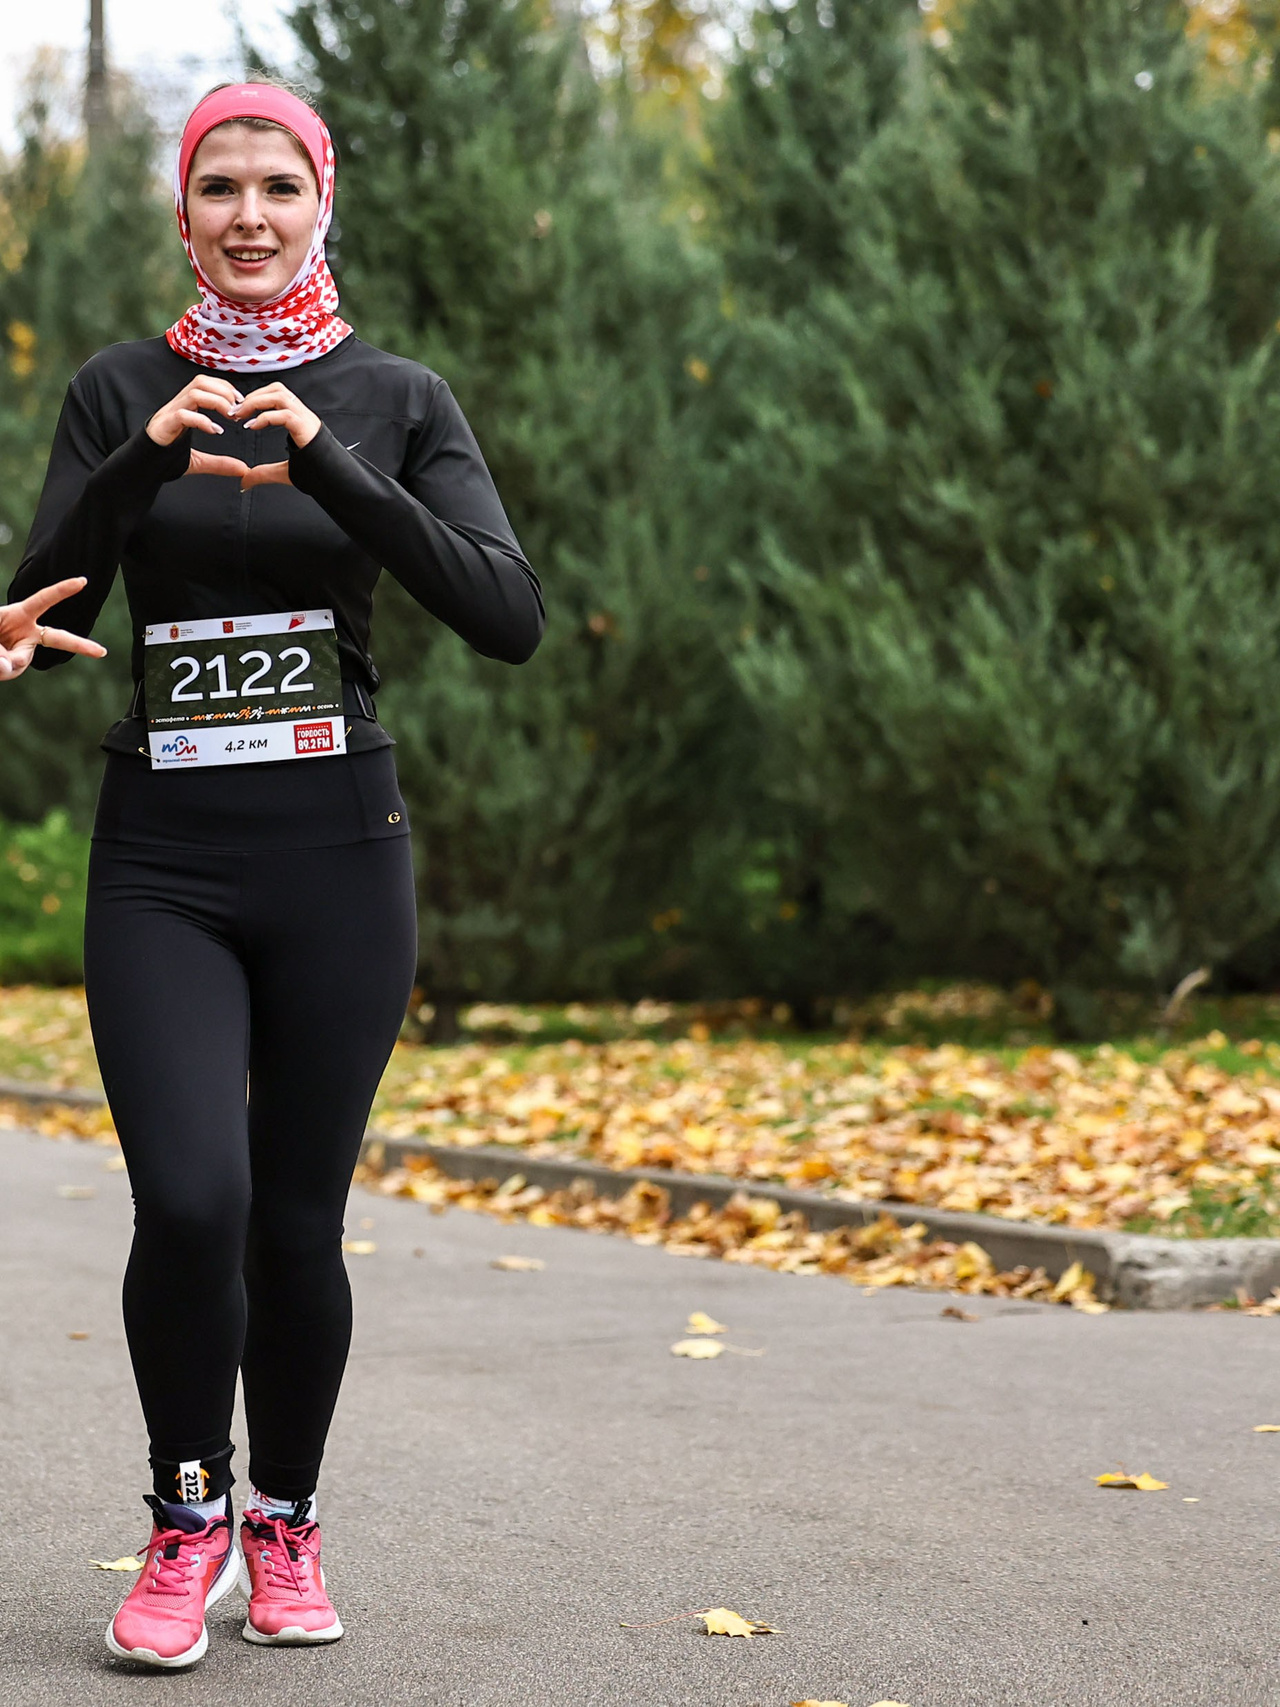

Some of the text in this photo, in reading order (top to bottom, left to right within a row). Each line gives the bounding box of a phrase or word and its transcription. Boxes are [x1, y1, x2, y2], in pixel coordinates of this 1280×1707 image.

[169, 646, 315, 703] 2122
[297, 728, 330, 739] ГОРДОСТЬ
[297, 737, 331, 751] 89.2 FM
